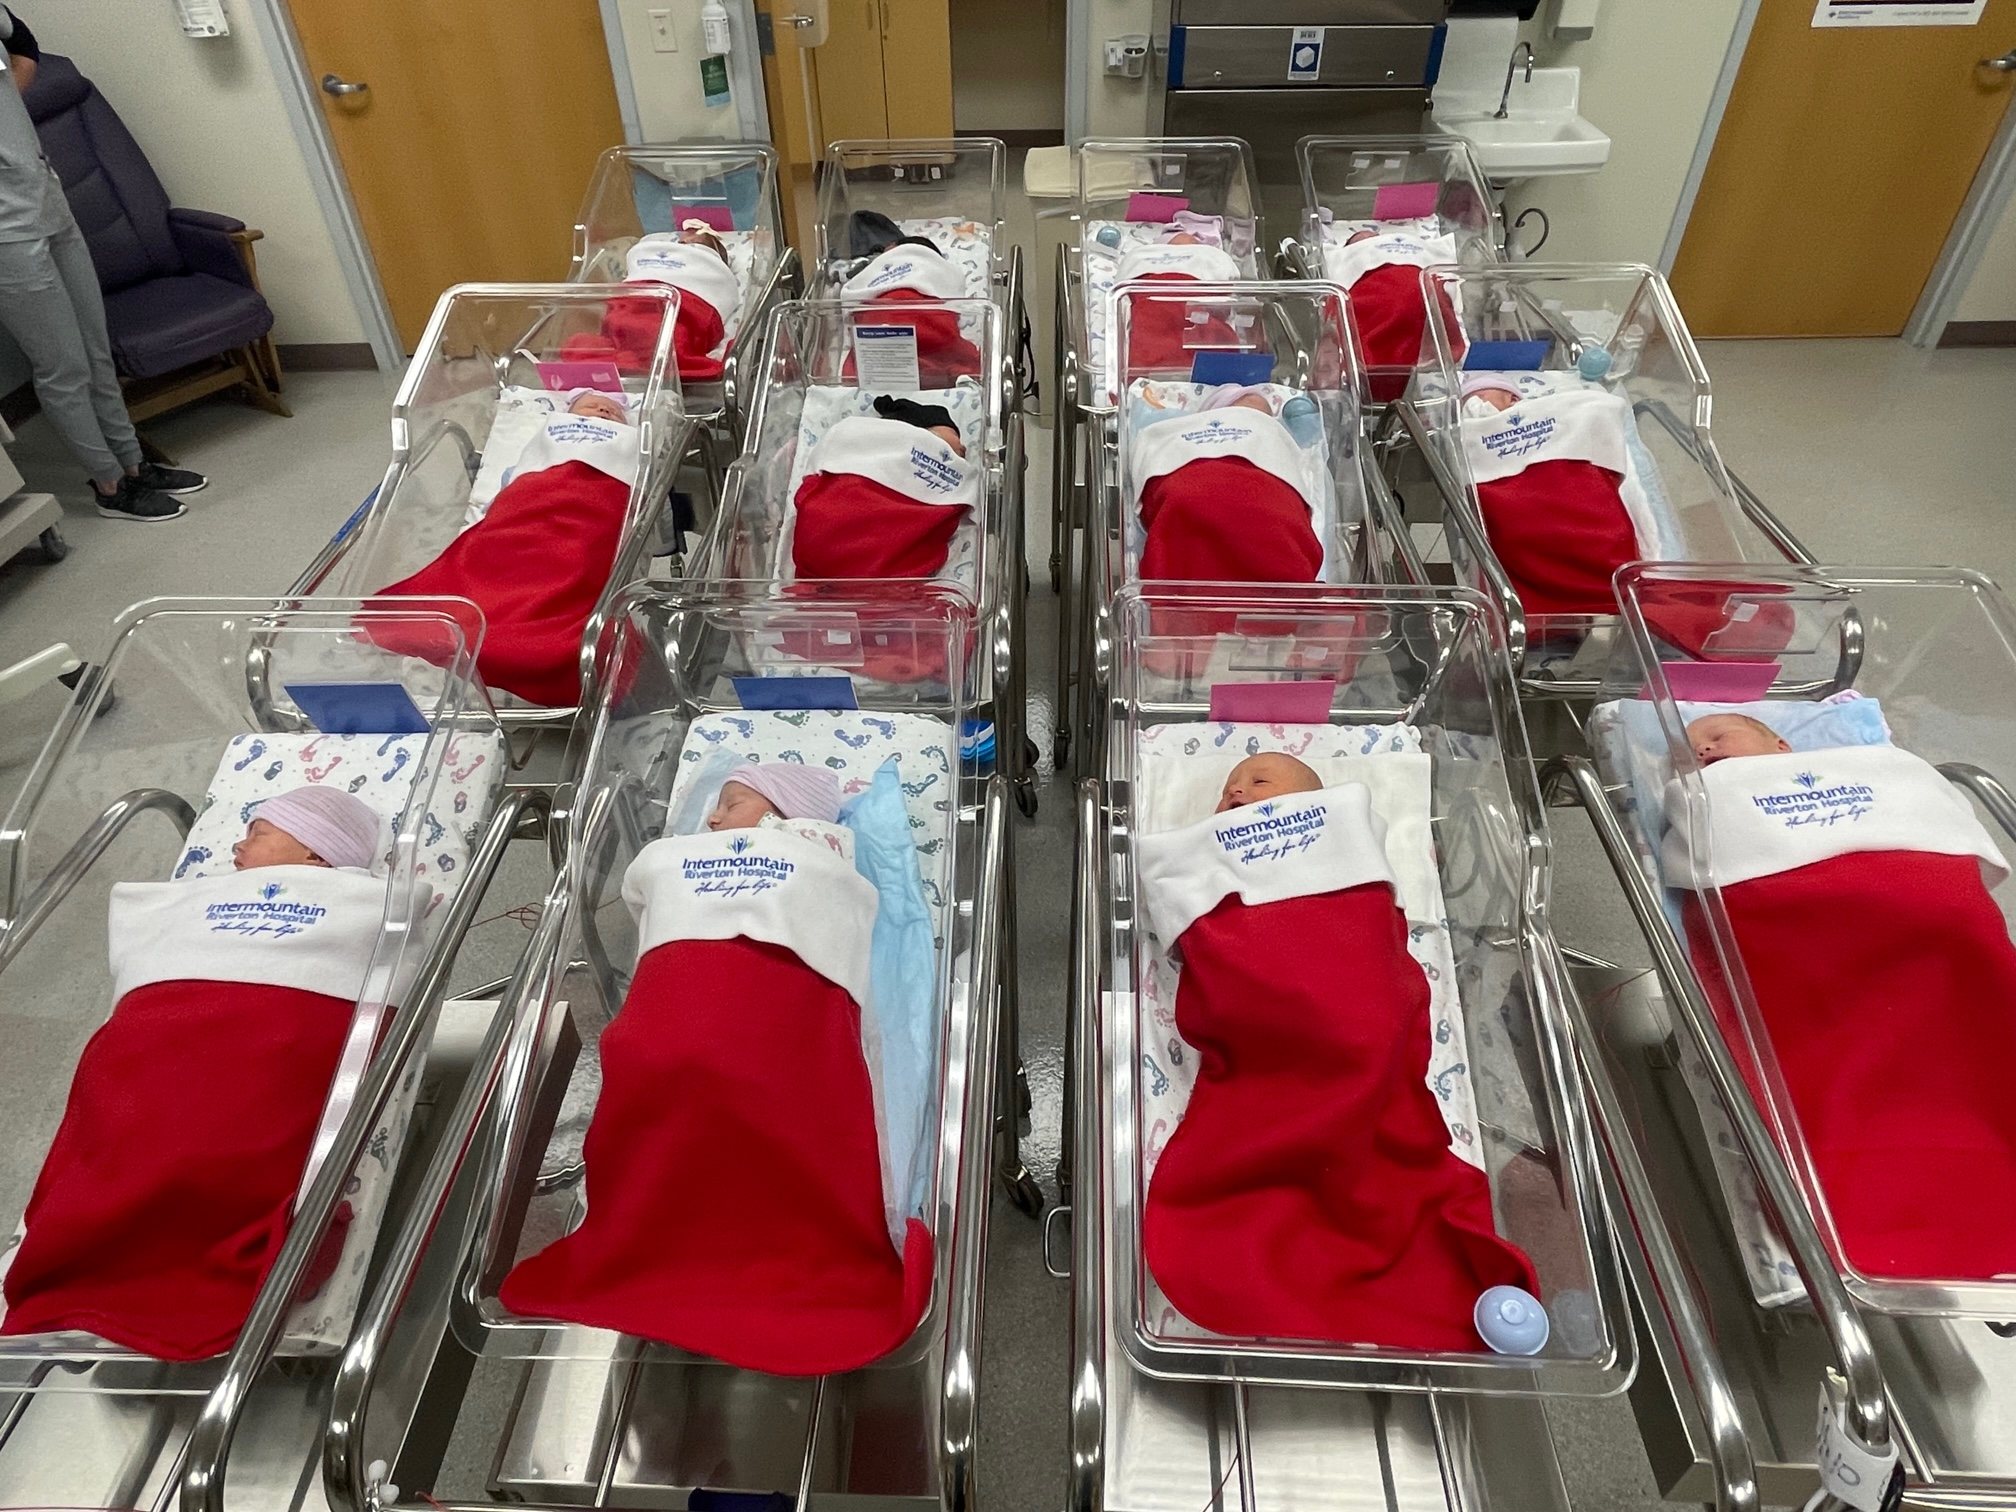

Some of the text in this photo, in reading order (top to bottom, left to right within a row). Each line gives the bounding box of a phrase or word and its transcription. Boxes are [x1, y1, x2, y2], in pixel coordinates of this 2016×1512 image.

[1482, 417, 1556, 444] Intermountain
[1752, 783, 1874, 806] Intermountain
[1763, 795, 1873, 815] Riverton Hospital
[1215, 804, 1327, 843] Intermountain
[1224, 817, 1325, 851] Riverton Hospital
[682, 856, 795, 873] Intermountain
[684, 867, 787, 881] Riverton Hospital
[205, 902, 327, 917] Intermountain
[205, 912, 317, 925] Riverton Hospital
